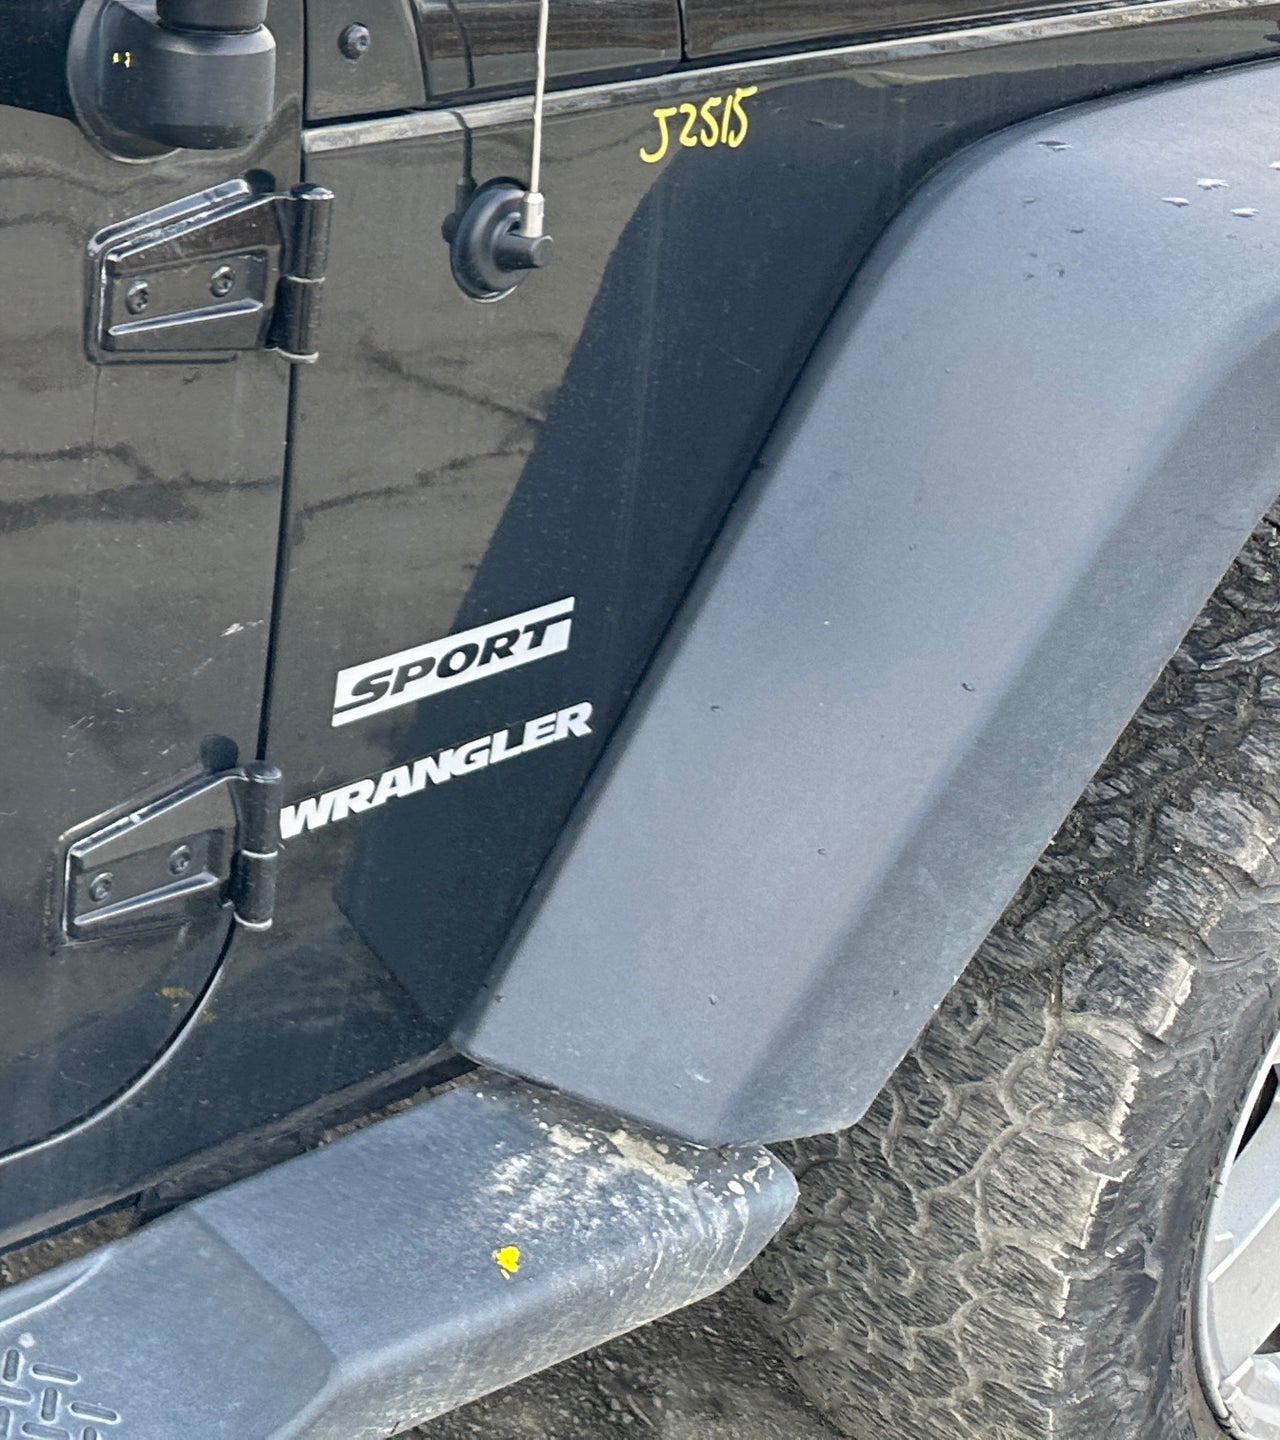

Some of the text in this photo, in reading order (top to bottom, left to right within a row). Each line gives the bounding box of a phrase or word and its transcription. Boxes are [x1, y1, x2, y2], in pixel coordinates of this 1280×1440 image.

[640, 86, 758, 164] J2515
[344, 616, 560, 708] SPORT
[280, 701, 593, 840] WRANGLER
